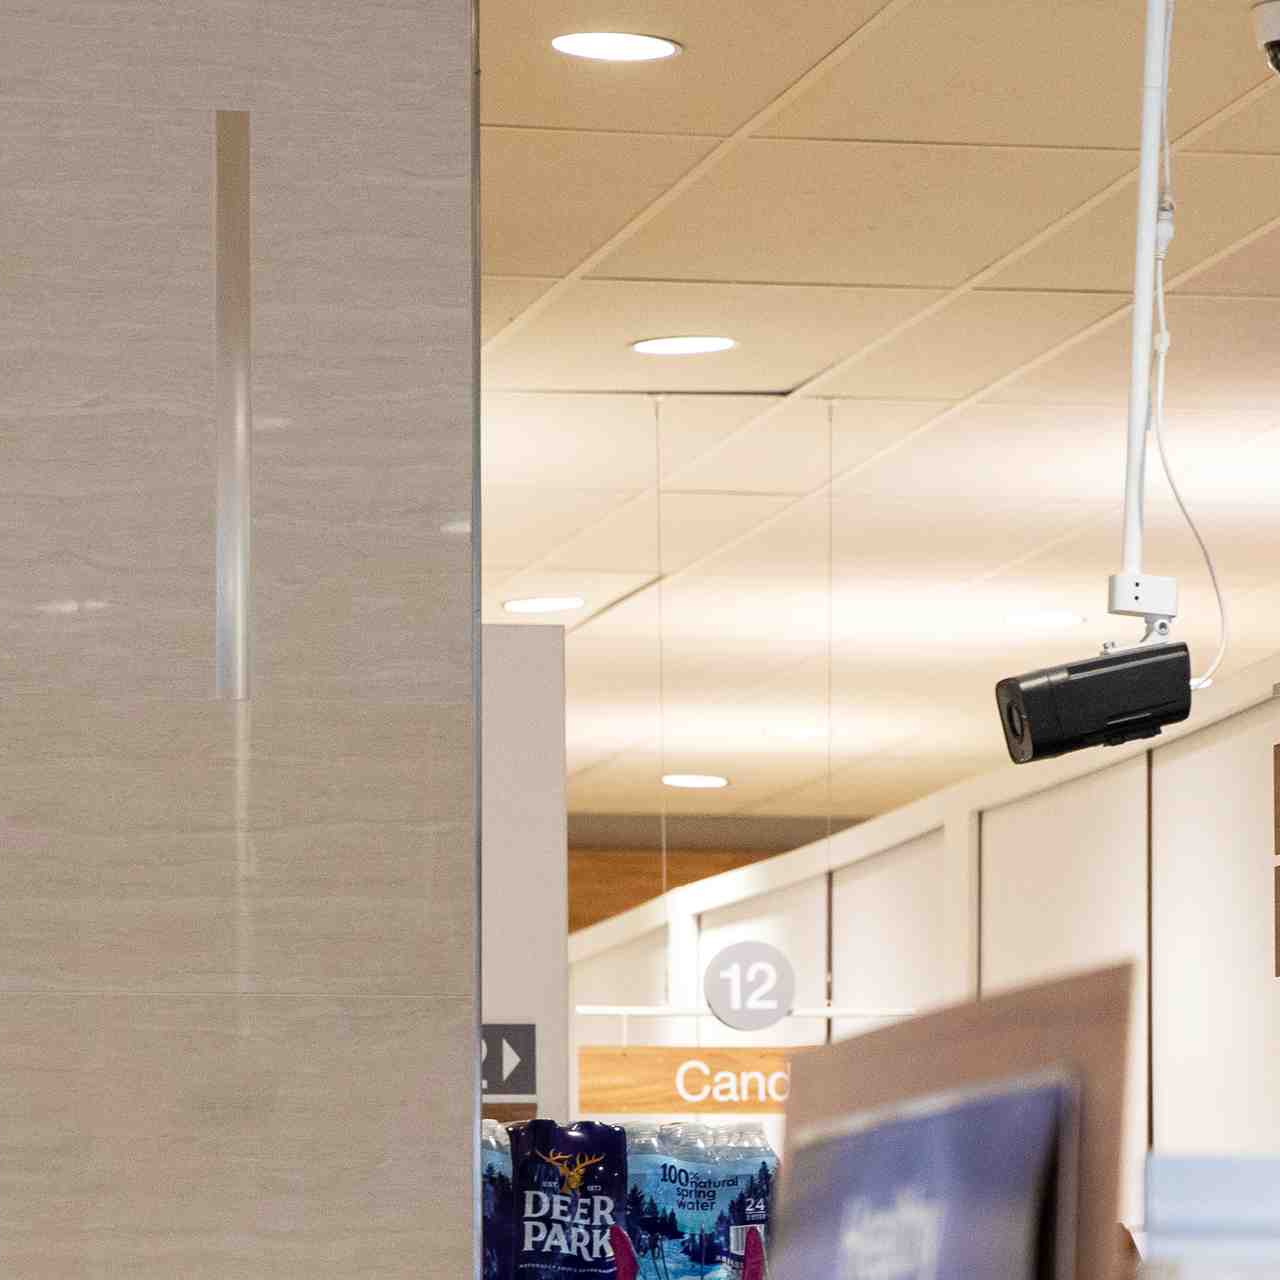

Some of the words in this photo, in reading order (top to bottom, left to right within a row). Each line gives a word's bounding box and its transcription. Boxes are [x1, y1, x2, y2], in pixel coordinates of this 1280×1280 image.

[719, 961, 779, 1010] 12
[690, 1175, 738, 1190] natural
[676, 1187, 717, 1201] spring
[522, 1190, 617, 1226] DEER
[676, 1199, 717, 1212] water
[745, 1198, 766, 1212] 24
[521, 1220, 615, 1262] PARK
